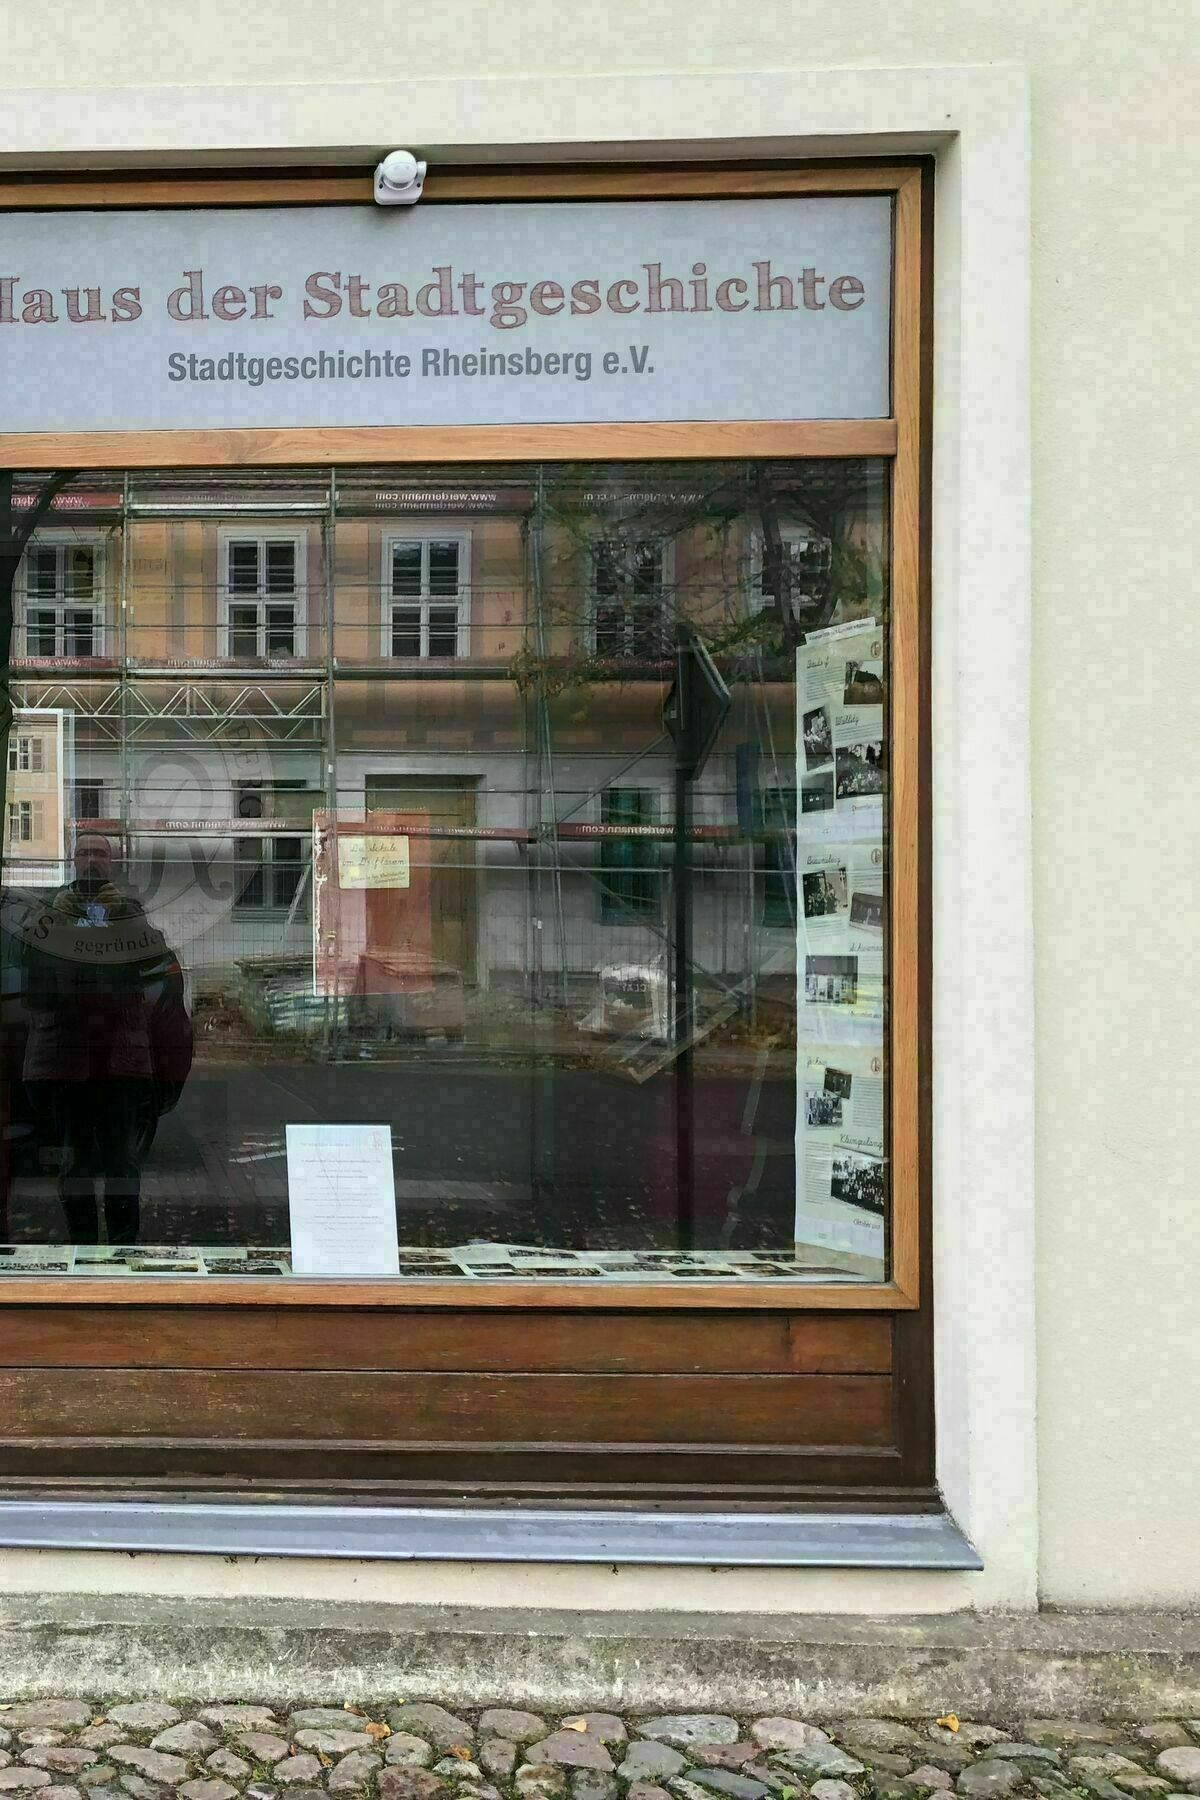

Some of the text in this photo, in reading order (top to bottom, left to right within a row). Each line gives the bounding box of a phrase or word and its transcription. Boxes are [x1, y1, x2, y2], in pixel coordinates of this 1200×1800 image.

[166, 269, 282, 322] der
[303, 260, 866, 330] Stadtgeschichte
[167, 345, 655, 387] Stadtgeschichte Rheinsberg e.V.
[73, 929, 164, 957] gegründe
